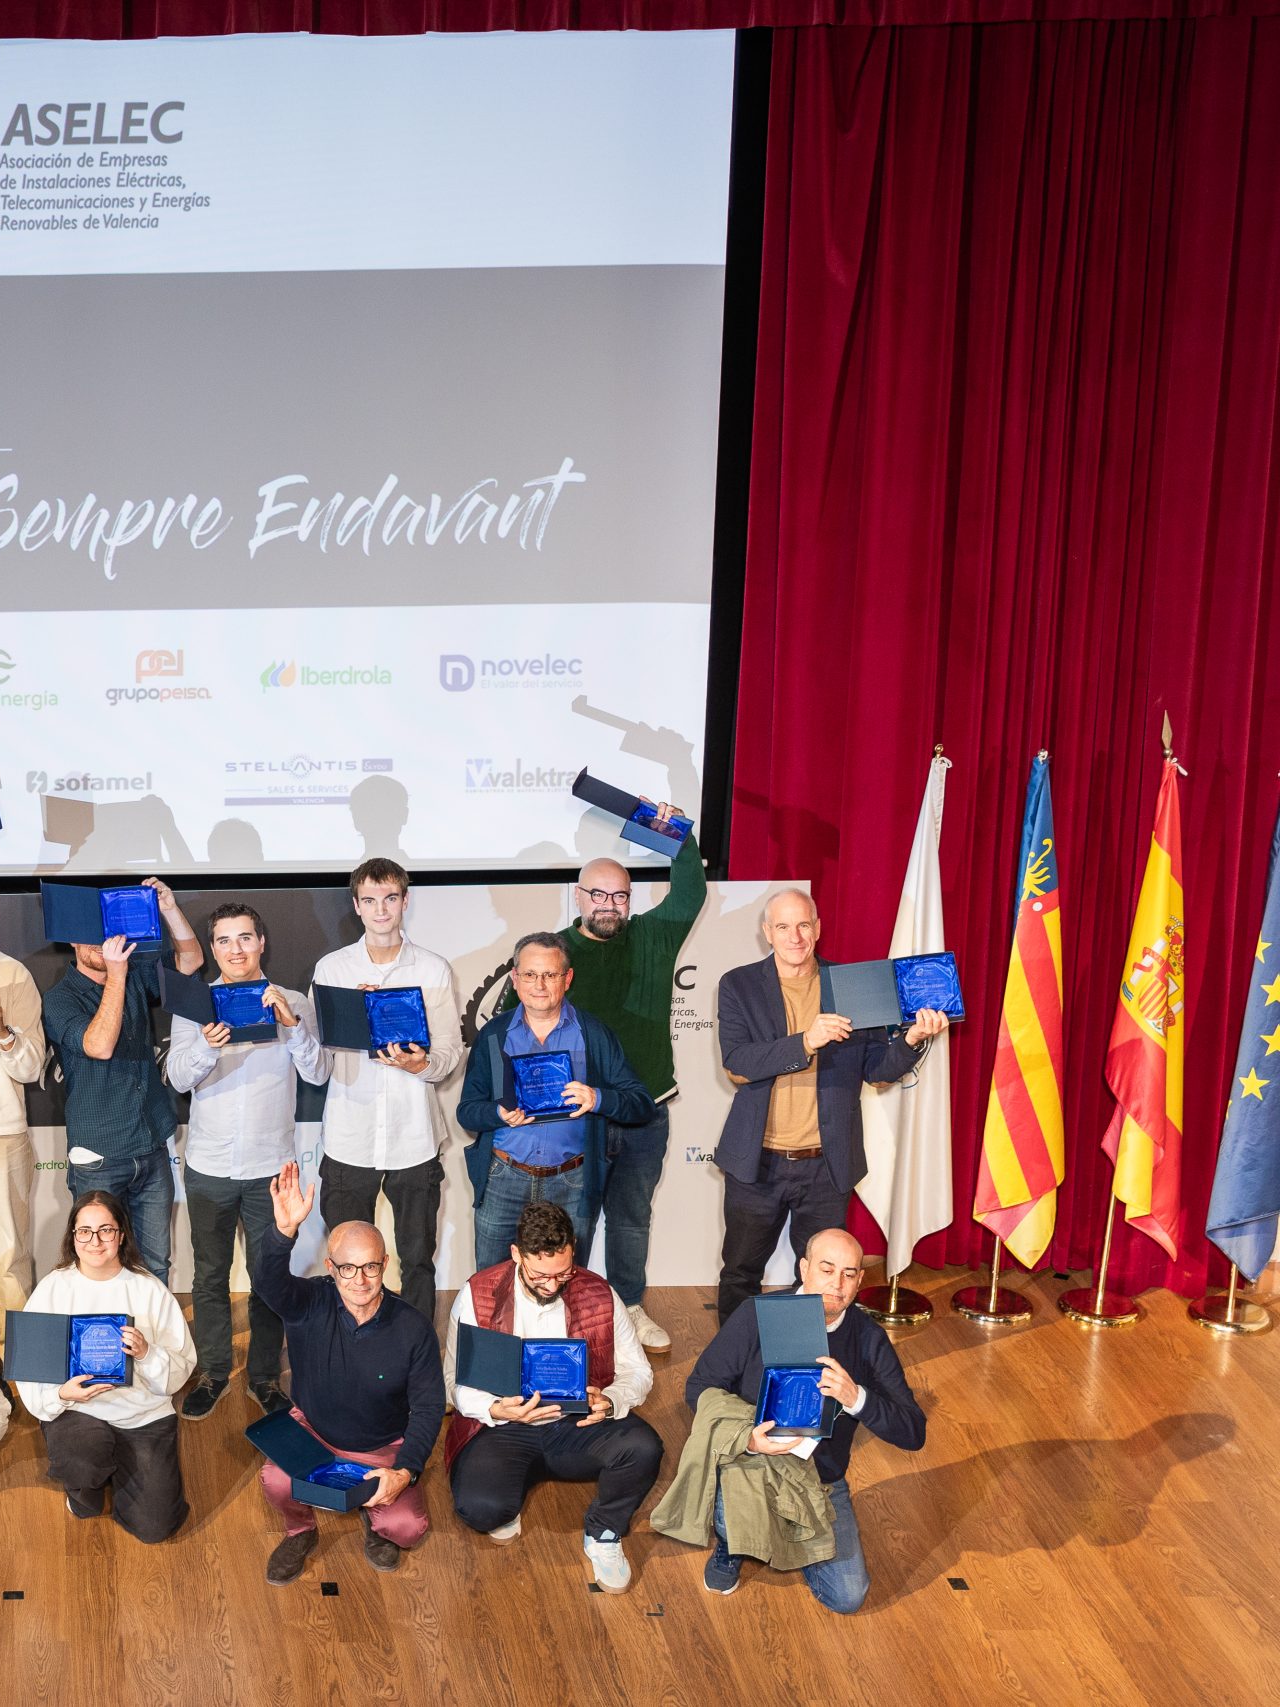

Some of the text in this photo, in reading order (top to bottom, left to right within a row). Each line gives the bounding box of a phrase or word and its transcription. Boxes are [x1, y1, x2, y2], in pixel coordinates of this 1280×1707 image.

[0, 101, 185, 146] ASELEC
[77, 153, 95, 168] de
[100, 152, 169, 172] Empresas
[0, 172, 187, 190] de Instalaciones Eléctricas,
[0, 192, 211, 213] Telecomunicaciones y Energías
[0, 214, 160, 231] Renovables de Valencia
[248, 456, 587, 559] Endavant
[481, 653, 583, 676] novelec
[301, 665, 392, 685] Iberdrola
[106, 687, 213, 706] grupopeisa
[225, 760, 357, 773] STELLANTIS
[54, 771, 153, 792] sofamel
[267, 785, 349, 794] SALES & SERVICES
[670, 1008, 697, 1018] tricas,
[674, 1019, 714, 1031] Energías
[35, 1159, 69, 1171] erdrol
